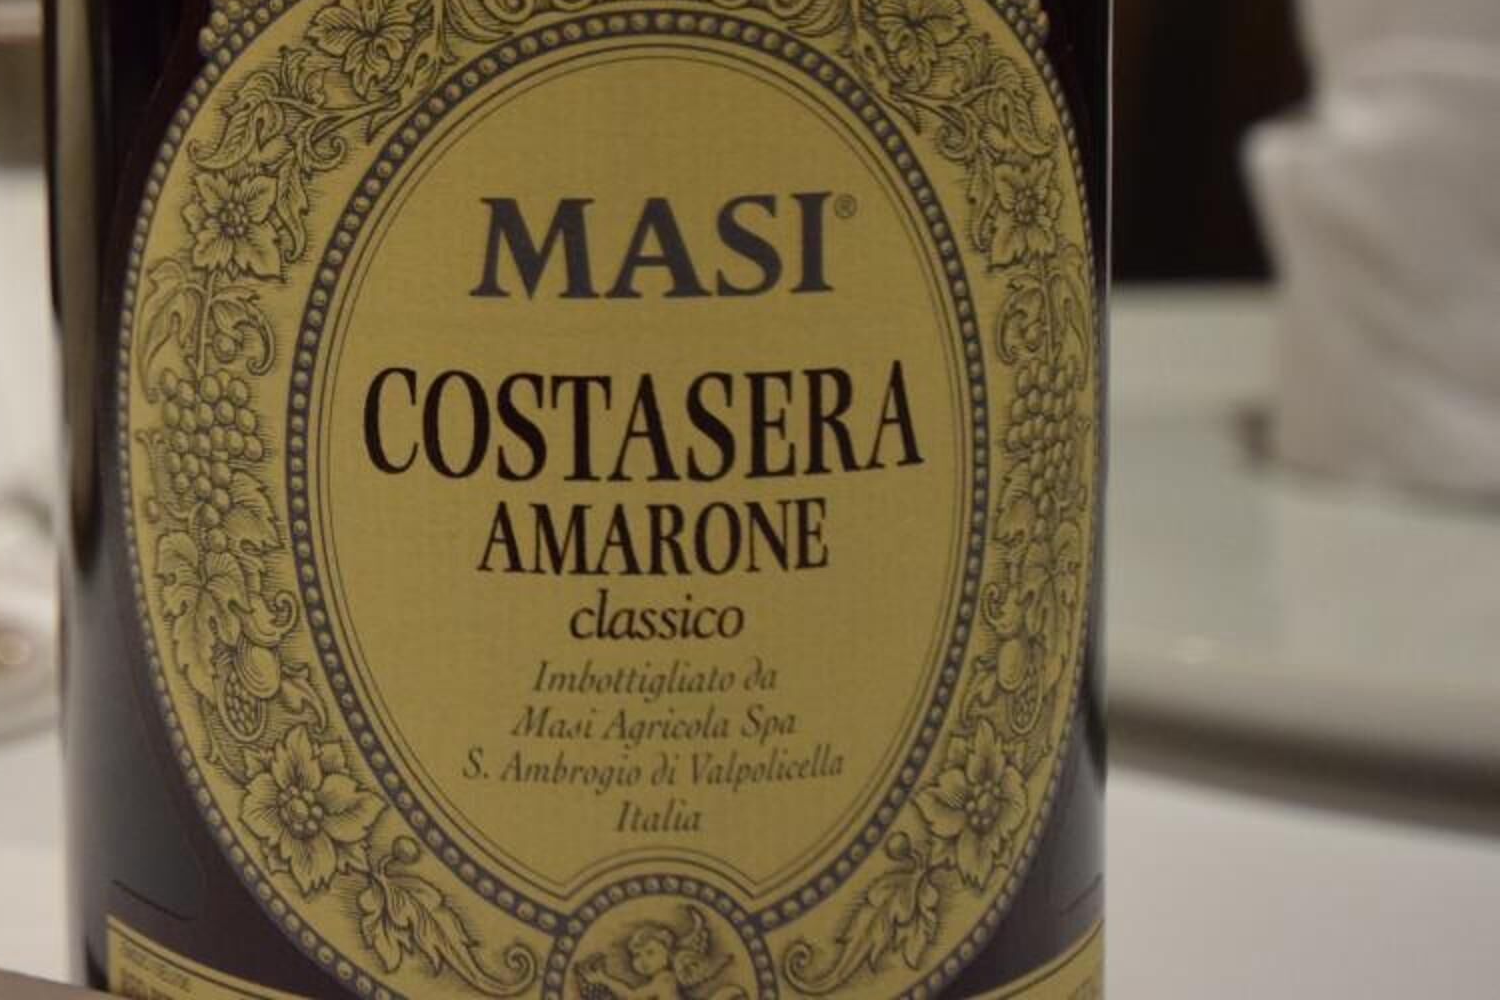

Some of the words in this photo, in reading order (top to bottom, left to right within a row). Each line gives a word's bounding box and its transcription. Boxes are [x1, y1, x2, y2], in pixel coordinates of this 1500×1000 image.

[363, 360, 925, 483] COSTASERA
[477, 497, 830, 576] AMARONE
[569, 588, 746, 641] classico
[531, 660, 736, 702] Imbottigliato
[743, 655, 778, 691] da
[510, 704, 596, 740] Masi
[602, 704, 730, 748] Agricola
[740, 703, 797, 744] Spa
[462, 747, 490, 780] S.
[501, 751, 642, 796] Ambrogio
[650, 754, 680, 787] di
[691, 744, 846, 794] Valpolicella
[616, 799, 702, 833] Italia
